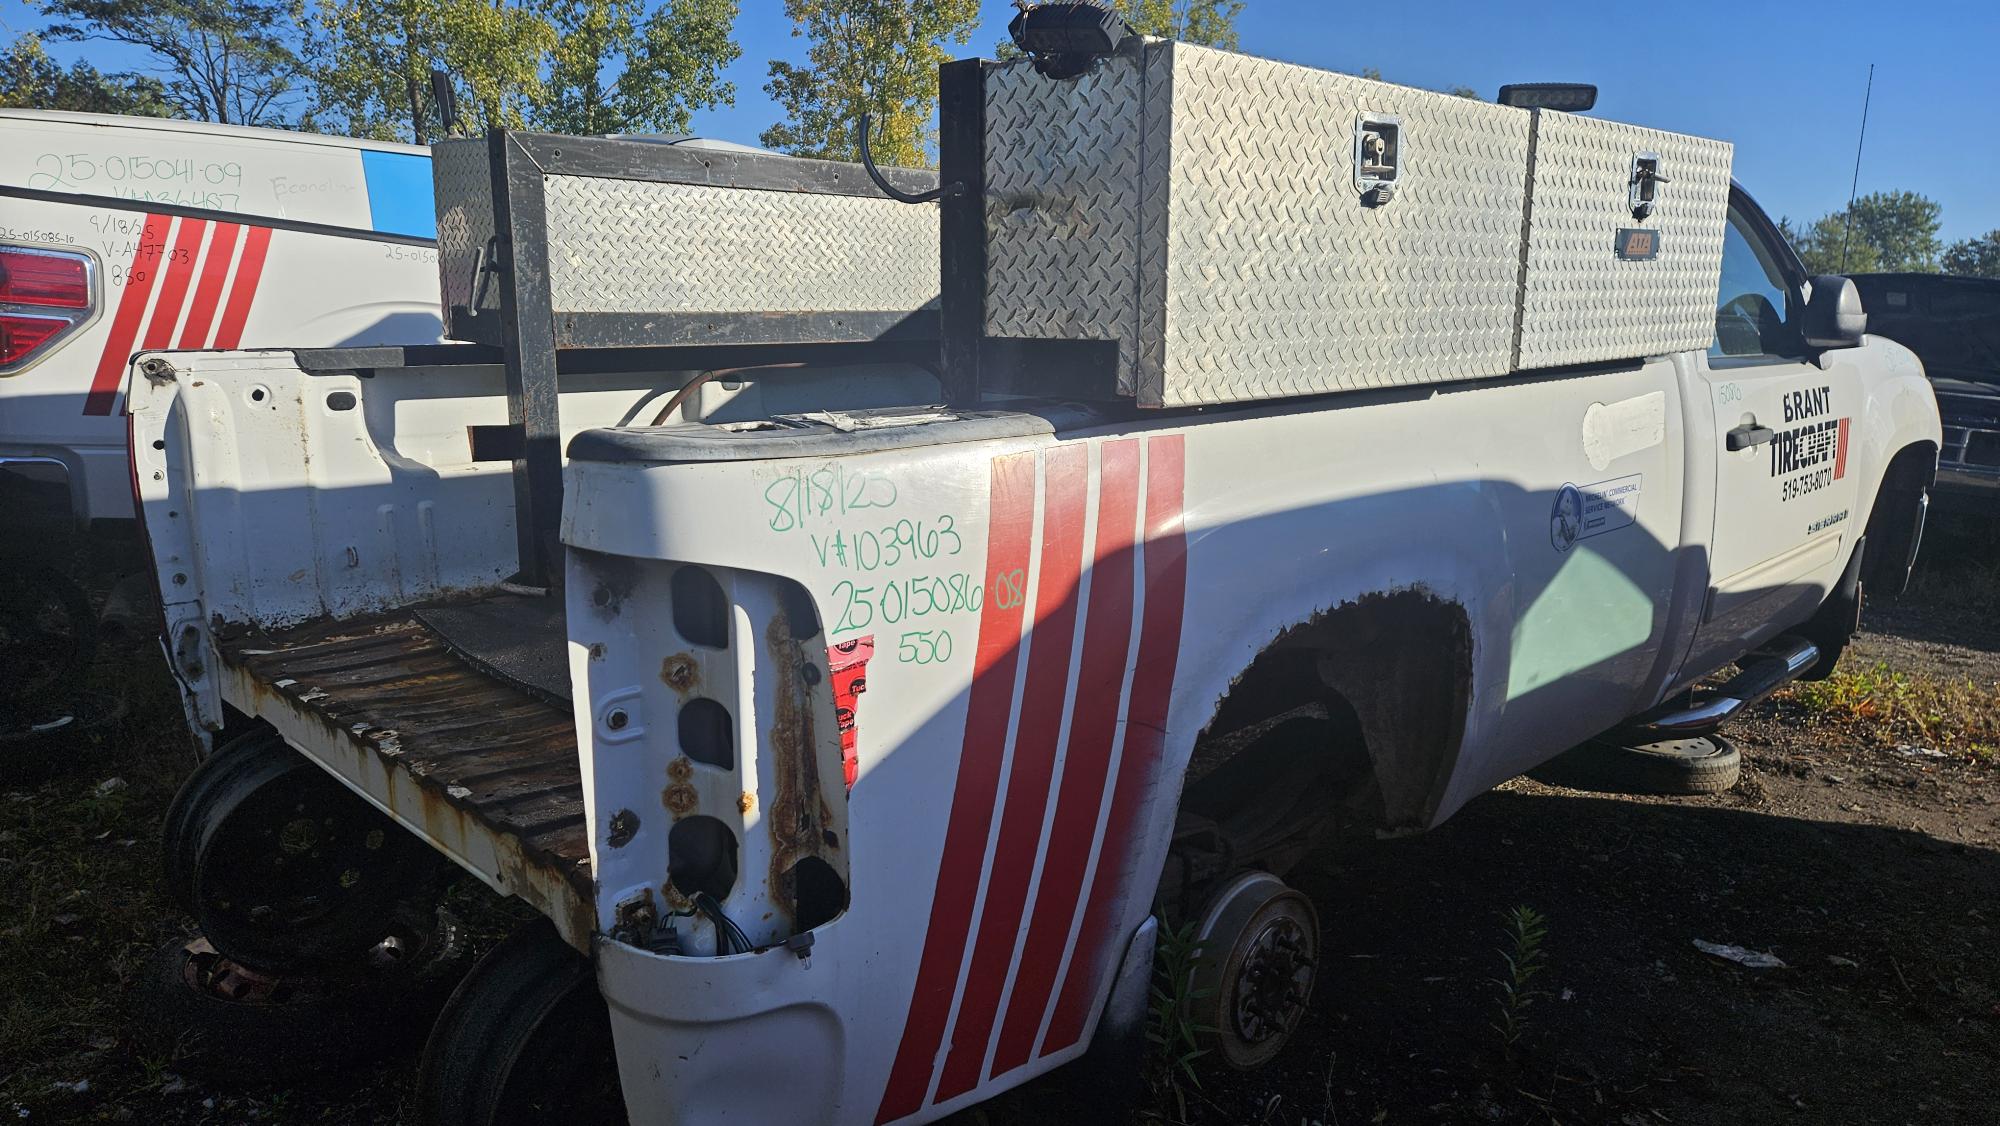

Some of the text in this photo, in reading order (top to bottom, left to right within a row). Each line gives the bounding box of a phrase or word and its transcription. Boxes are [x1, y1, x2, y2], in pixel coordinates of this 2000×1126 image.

[112, 265, 146, 286] 850
[1783, 386, 1830, 423] BRANT
[1770, 419, 1838, 477] TIRECRAFT
[1782, 467, 1832, 502] 519-753-8070
[899, 630, 952, 665] 550
